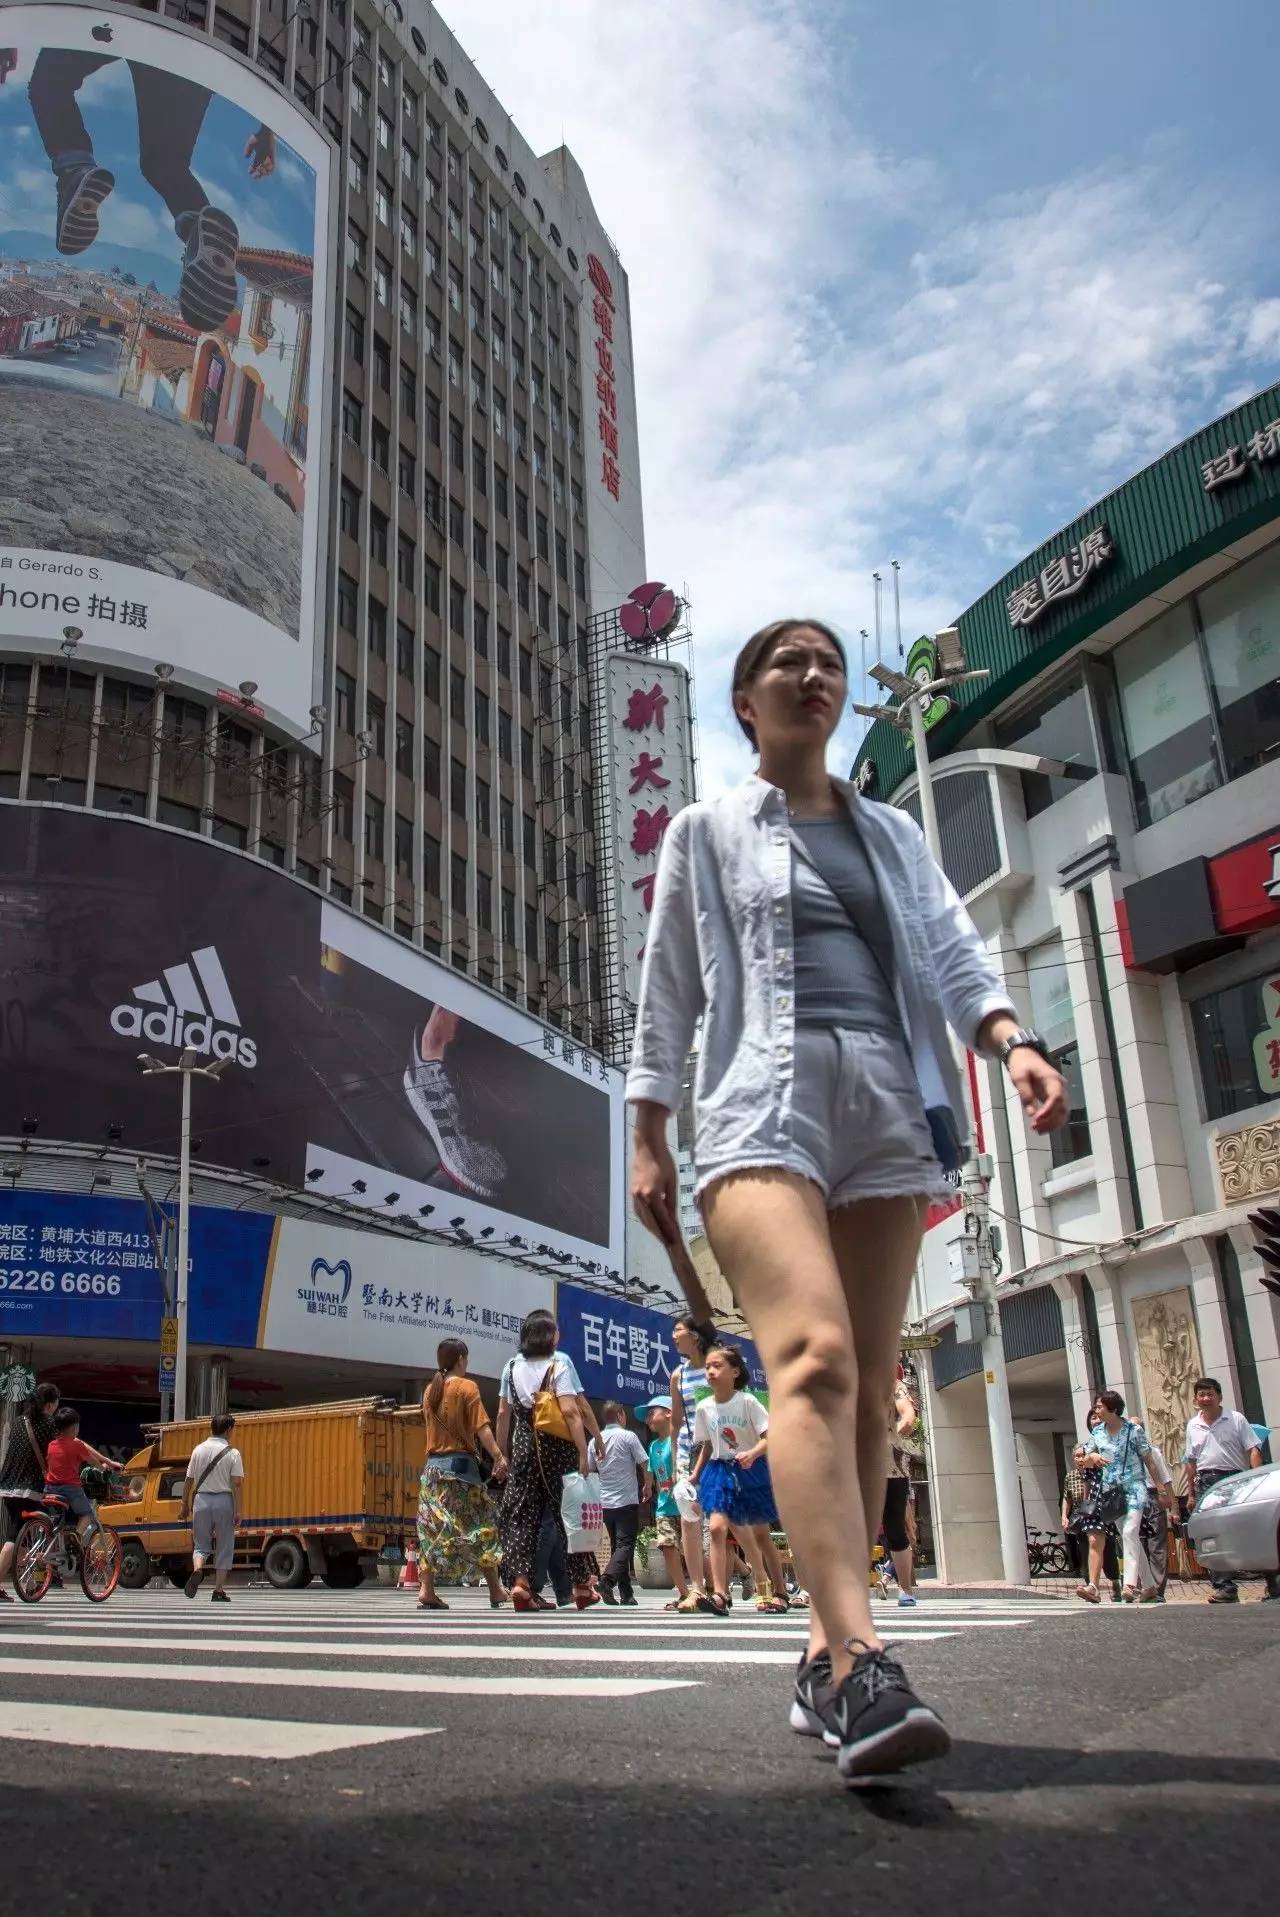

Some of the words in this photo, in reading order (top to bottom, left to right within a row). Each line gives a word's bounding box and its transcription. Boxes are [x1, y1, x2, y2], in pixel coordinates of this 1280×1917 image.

[1, 557, 13, 569] 自
[18, 558, 83, 577] Gerardo
[88, 567, 104, 581] S.
[0, 583, 81, 614] hone
[87, 593, 148, 630] 拍摄
[110, 1004, 257, 1068] adidas
[61, 1272, 121, 1295] 6666
[363, 1309, 377, 1321] The
[581, 1312, 671, 1380] 百年暨大
